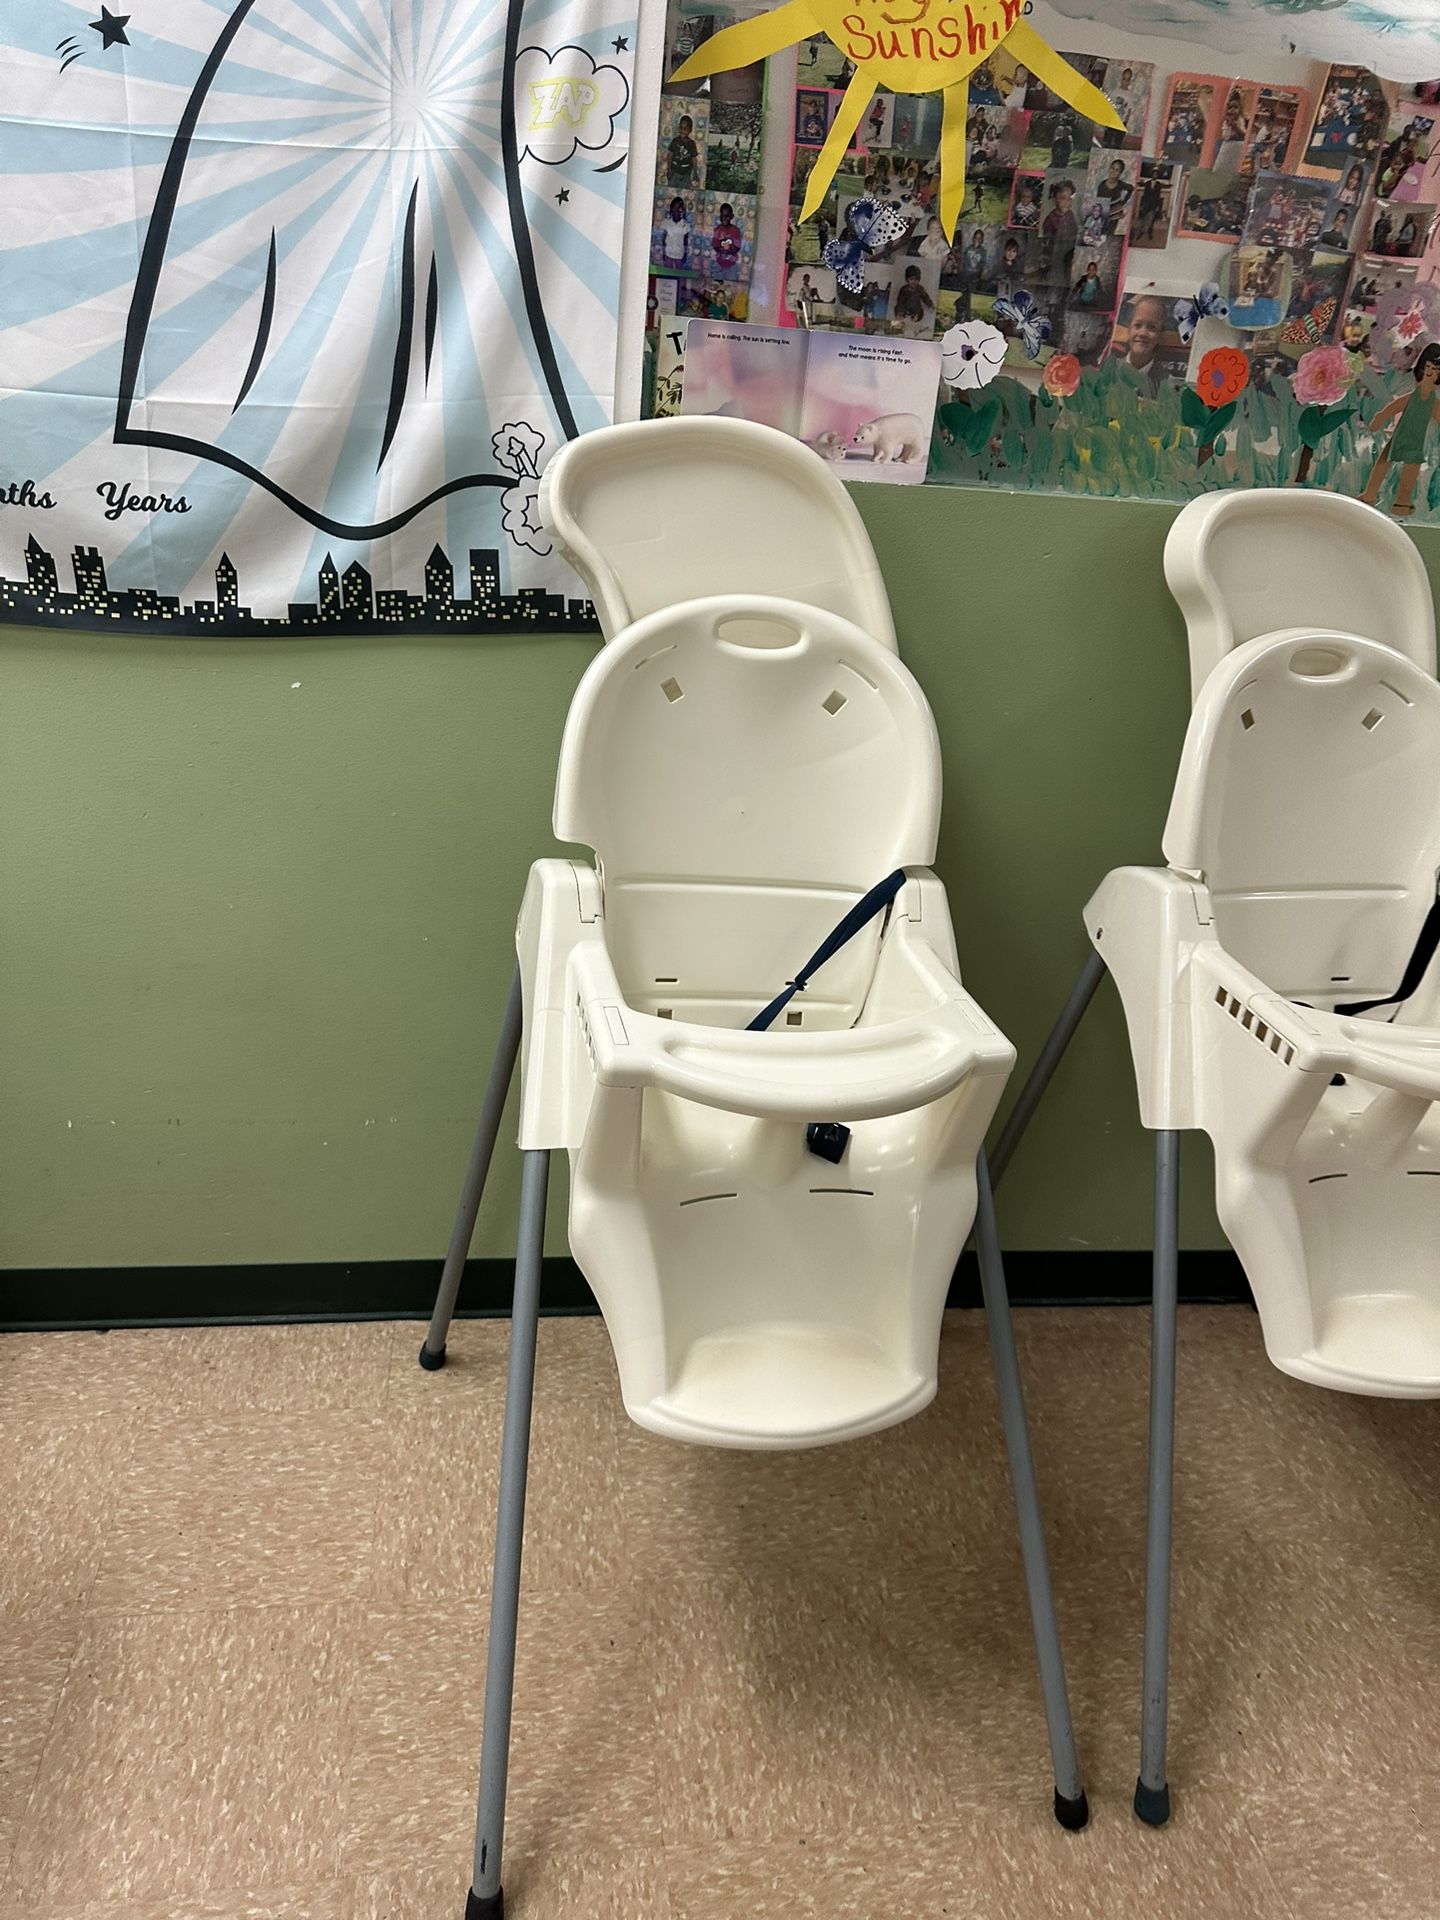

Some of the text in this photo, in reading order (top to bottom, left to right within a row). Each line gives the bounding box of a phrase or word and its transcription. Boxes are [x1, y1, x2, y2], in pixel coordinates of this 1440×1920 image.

[530, 79, 598, 128] ZAP
[765, 337, 780, 345] setting
[0, 479, 192, 520] ths Years
